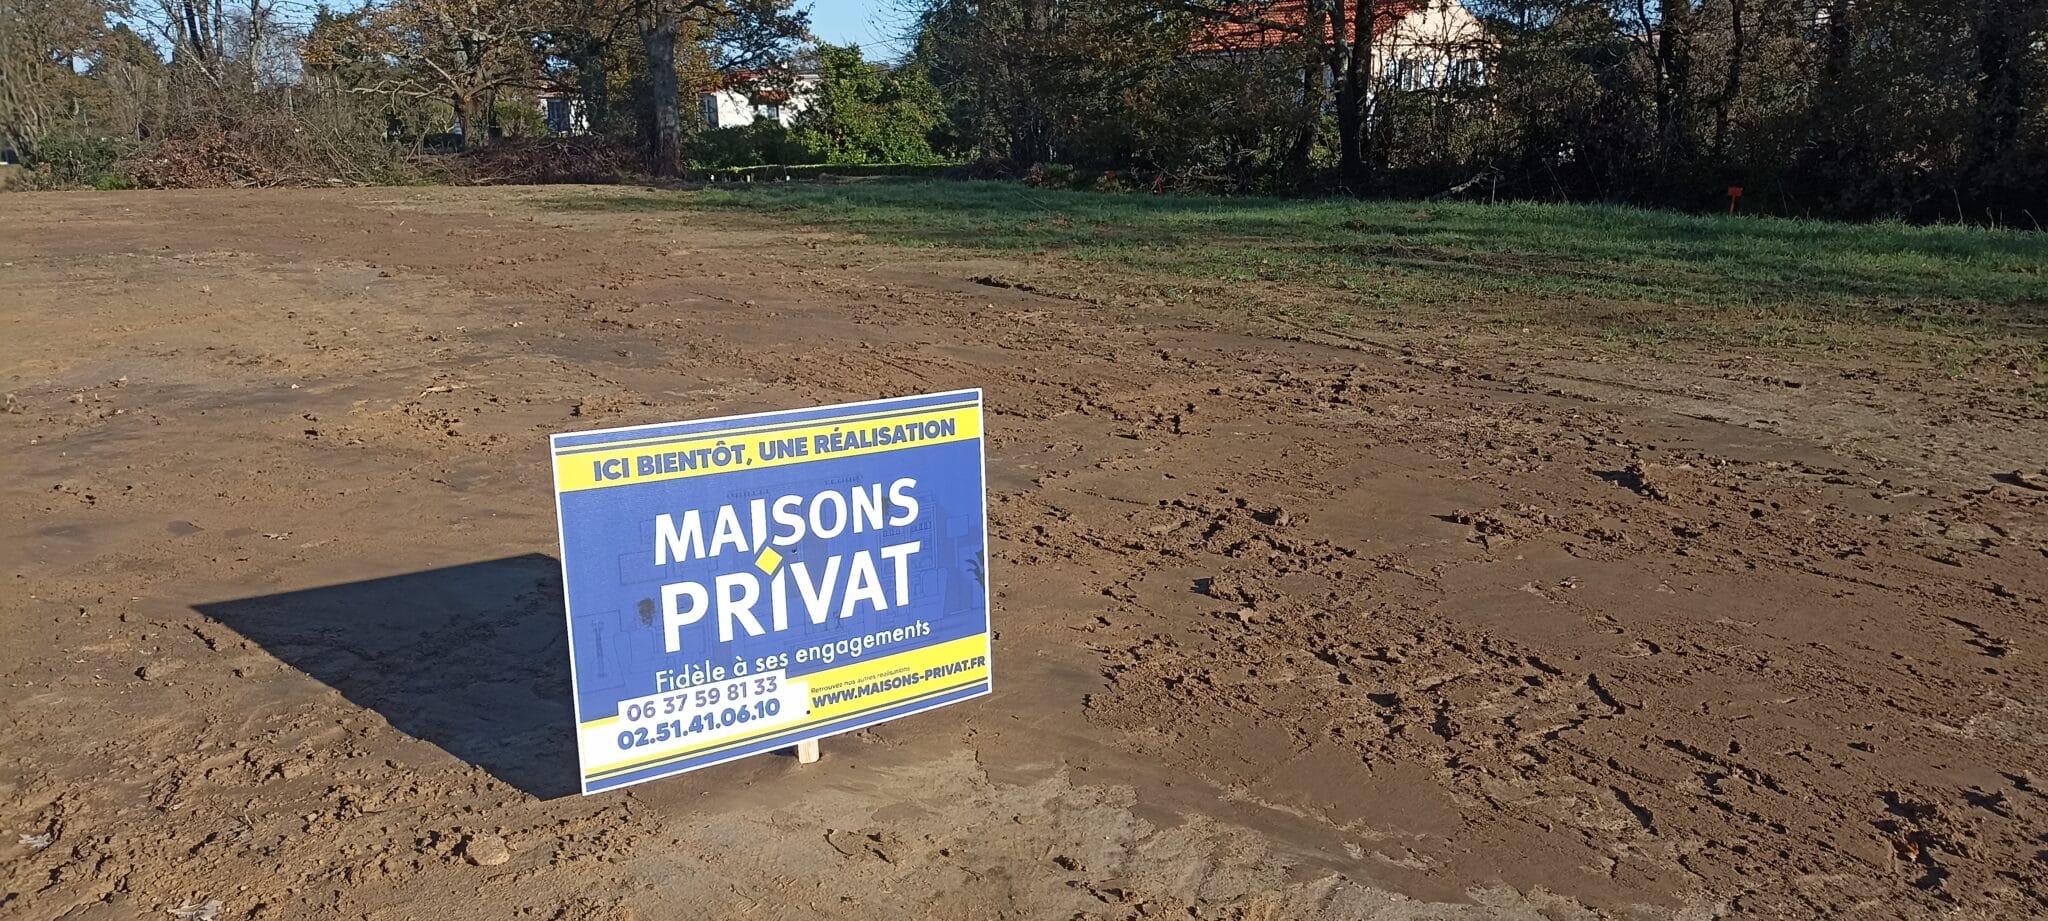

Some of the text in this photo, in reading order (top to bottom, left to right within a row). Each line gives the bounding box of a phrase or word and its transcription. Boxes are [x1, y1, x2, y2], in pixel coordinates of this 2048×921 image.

[593, 417, 956, 482] ICI BIENTÔT, UNE RÉALISATION
[654, 477, 920, 566] MAISONS
[655, 618, 931, 693] Fidèle à ses engagements
[811, 655, 986, 709] WWW.MAISONS-PRIVAT.FR
[626, 675, 778, 722] 06 37 59 81 33
[810, 681, 843, 694] Retrouvez
[843, 679, 856, 687] nos
[617, 697, 781, 751] 02.51.41.06.10
